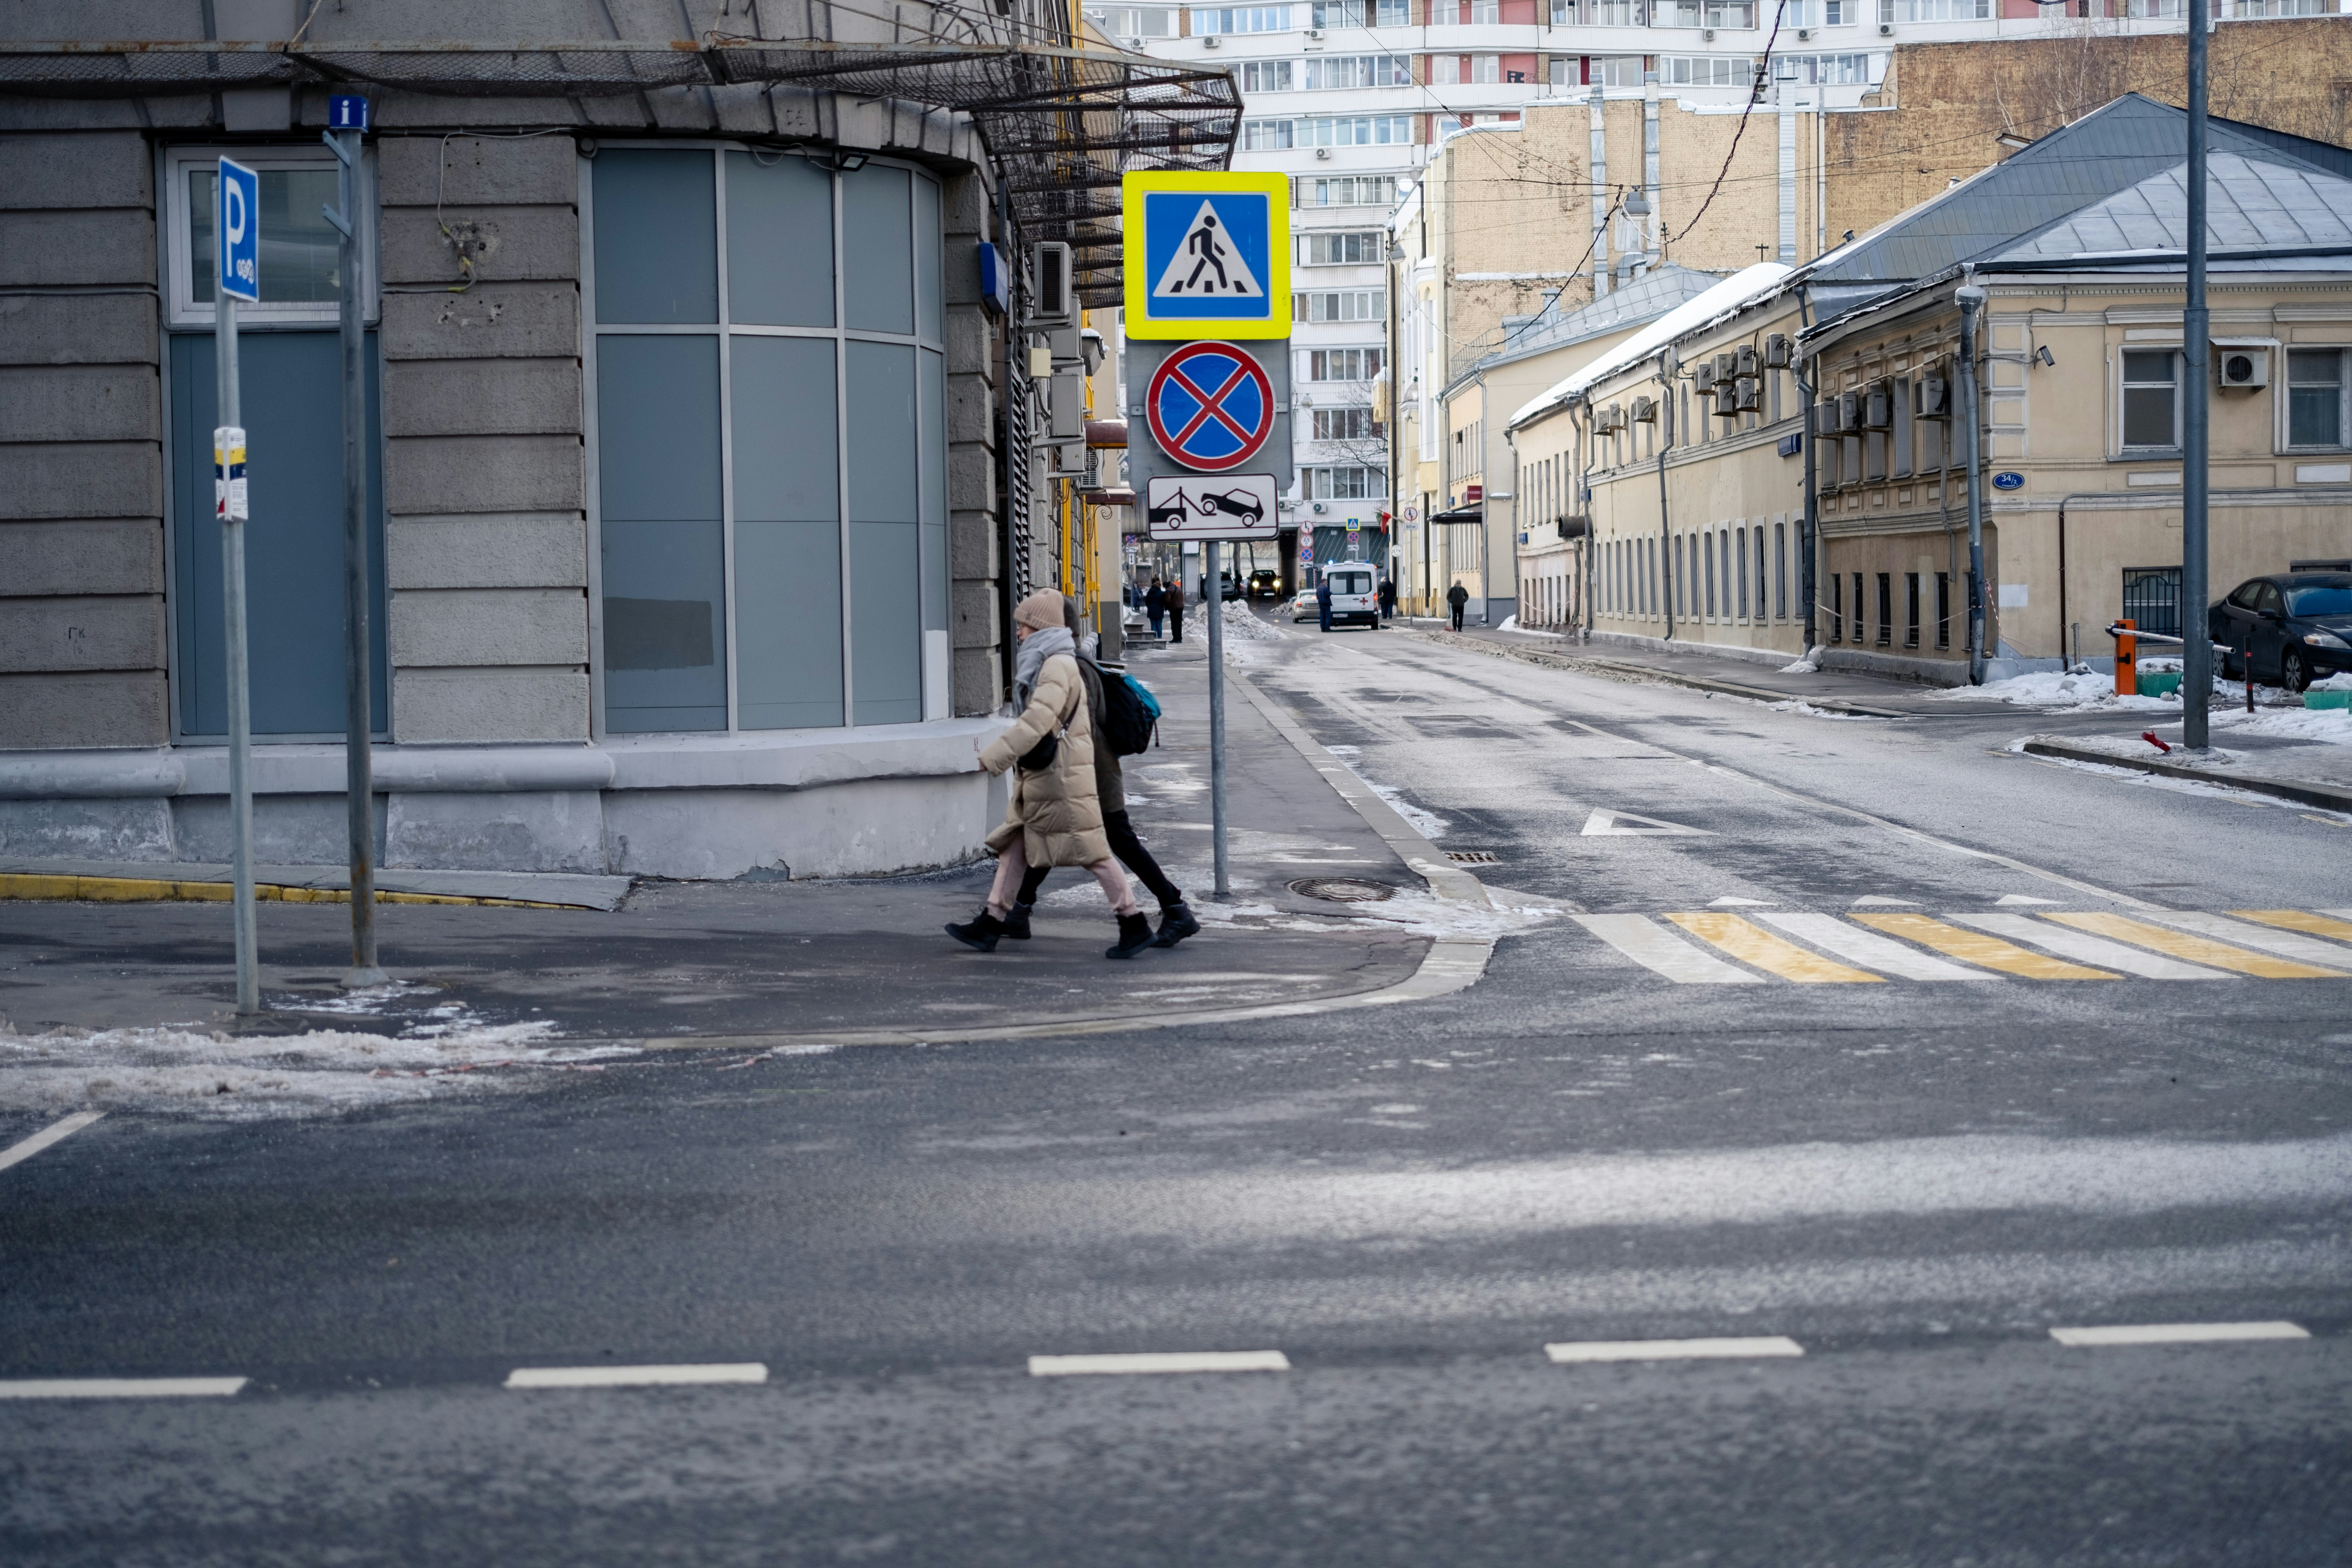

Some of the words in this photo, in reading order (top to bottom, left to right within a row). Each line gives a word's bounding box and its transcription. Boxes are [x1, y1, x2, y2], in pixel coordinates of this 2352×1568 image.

[341, 100, 350, 124] i
[225, 176, 245, 277] P
[247, 264, 254, 280] 20
